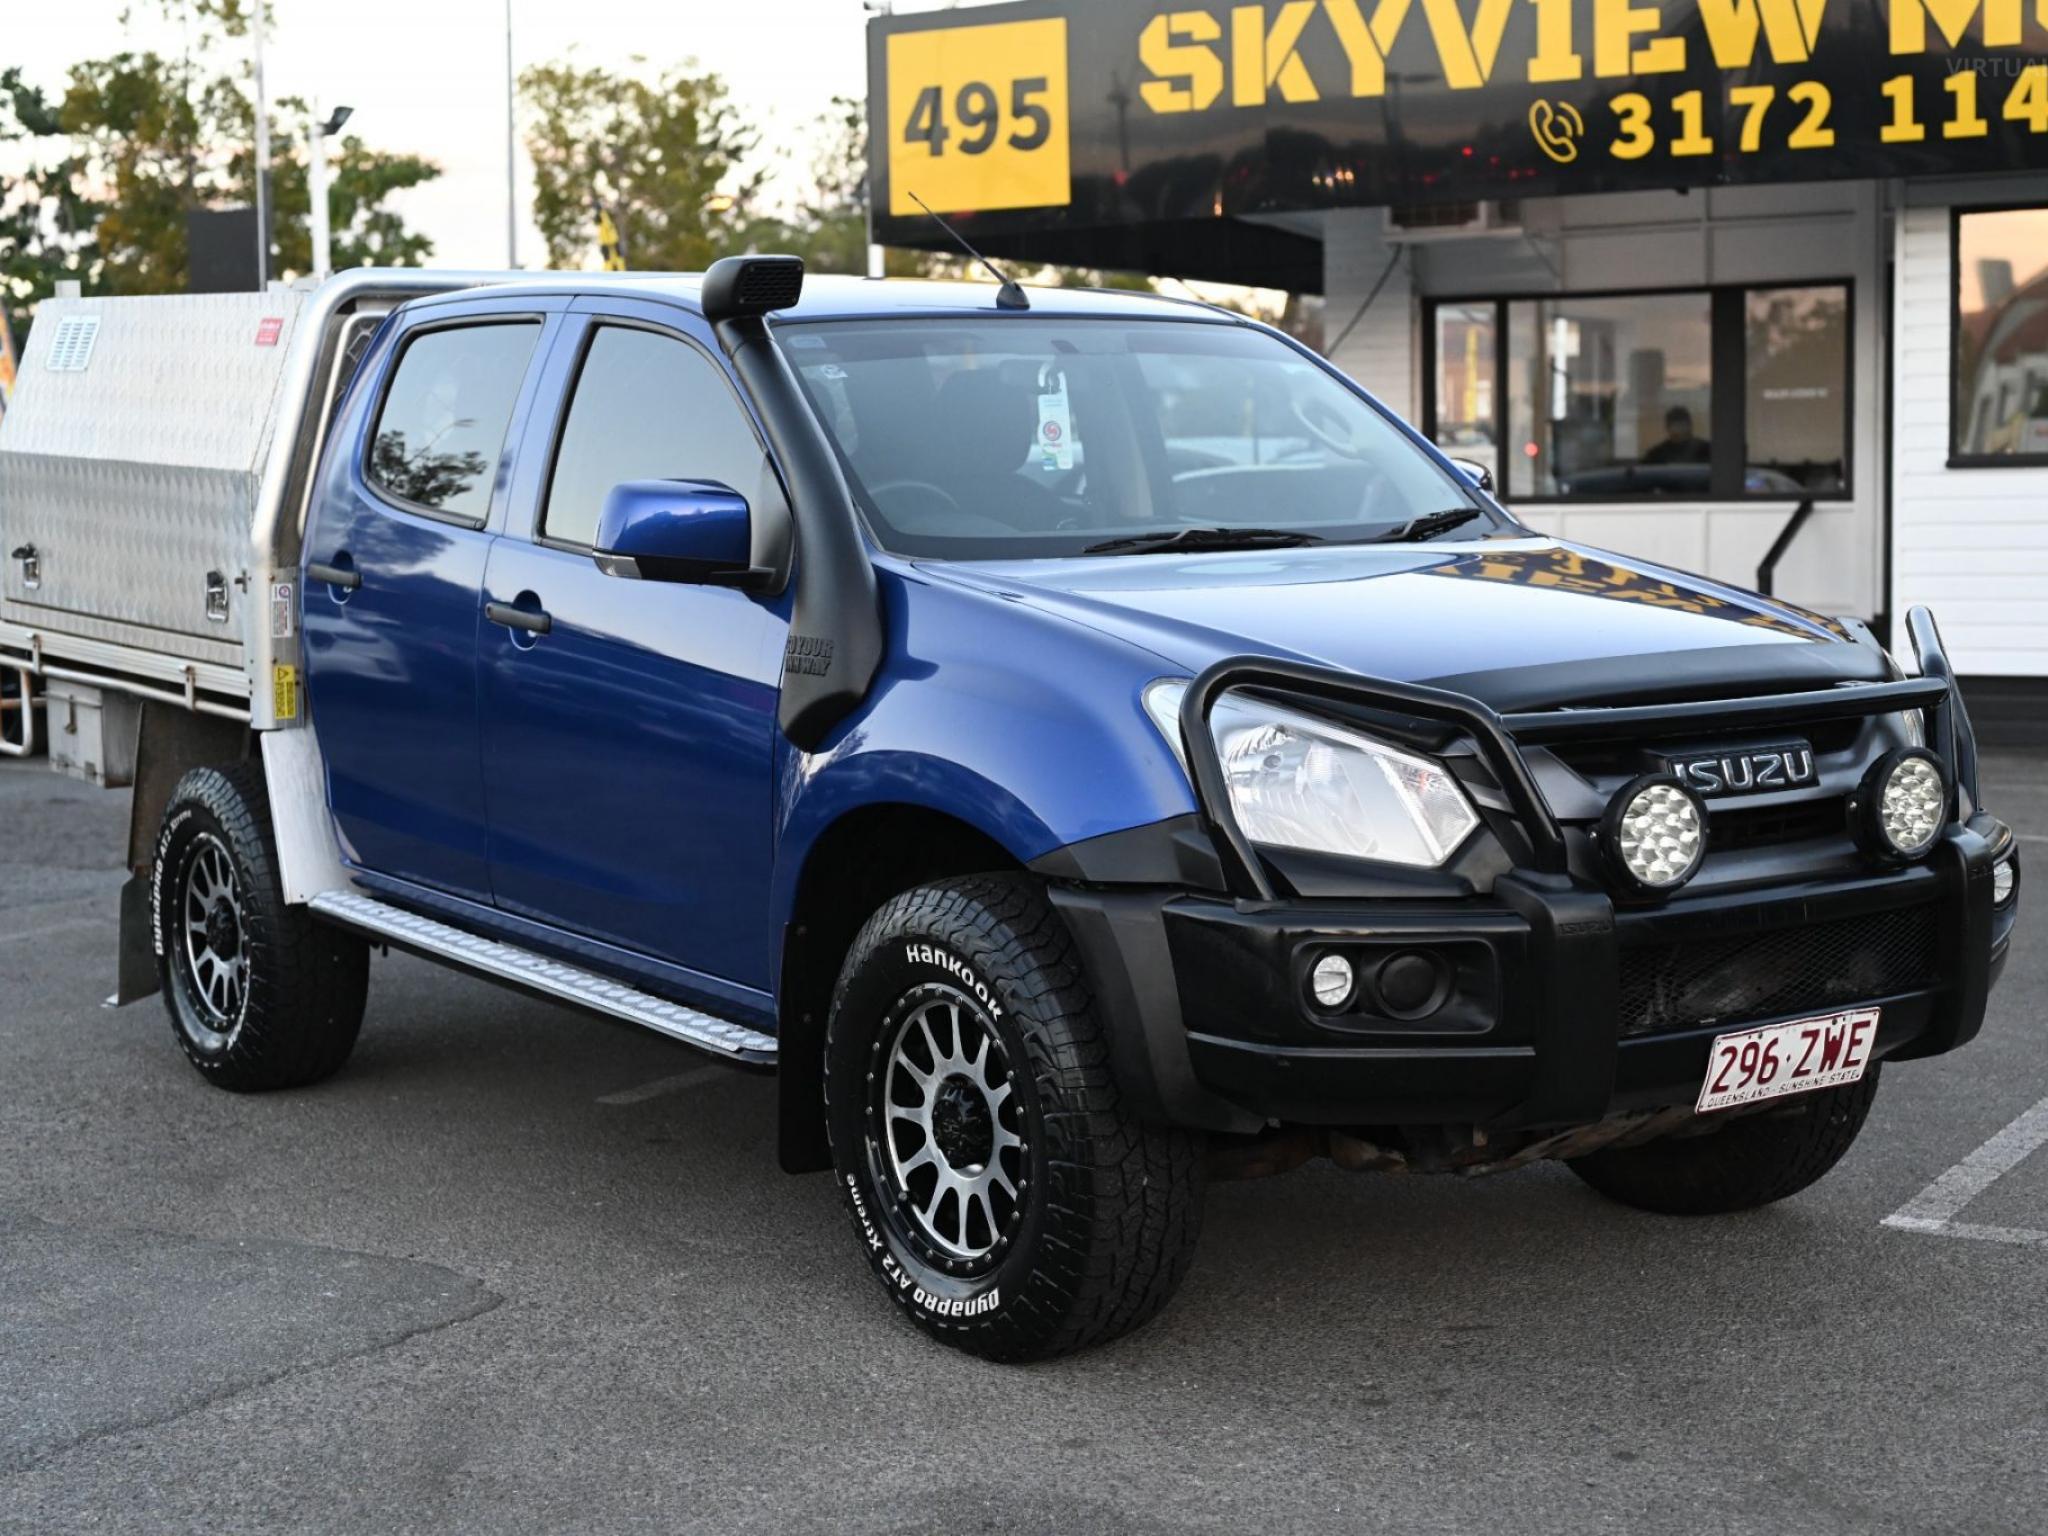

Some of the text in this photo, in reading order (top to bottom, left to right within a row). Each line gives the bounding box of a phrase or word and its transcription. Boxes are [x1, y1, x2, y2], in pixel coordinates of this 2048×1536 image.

[1139, 0, 2048, 114] SKYVIEW M
[904, 76, 1051, 157] 495
[1608, 80, 1834, 160] 3172
[1674, 750, 1814, 793] ISUZU
[1707, 1069, 1857, 1108] QUEENSLAND SUNSHINE STATE
[847, 1174, 883, 1251] Xtreme
[882, 1253, 912, 1289] AT2
